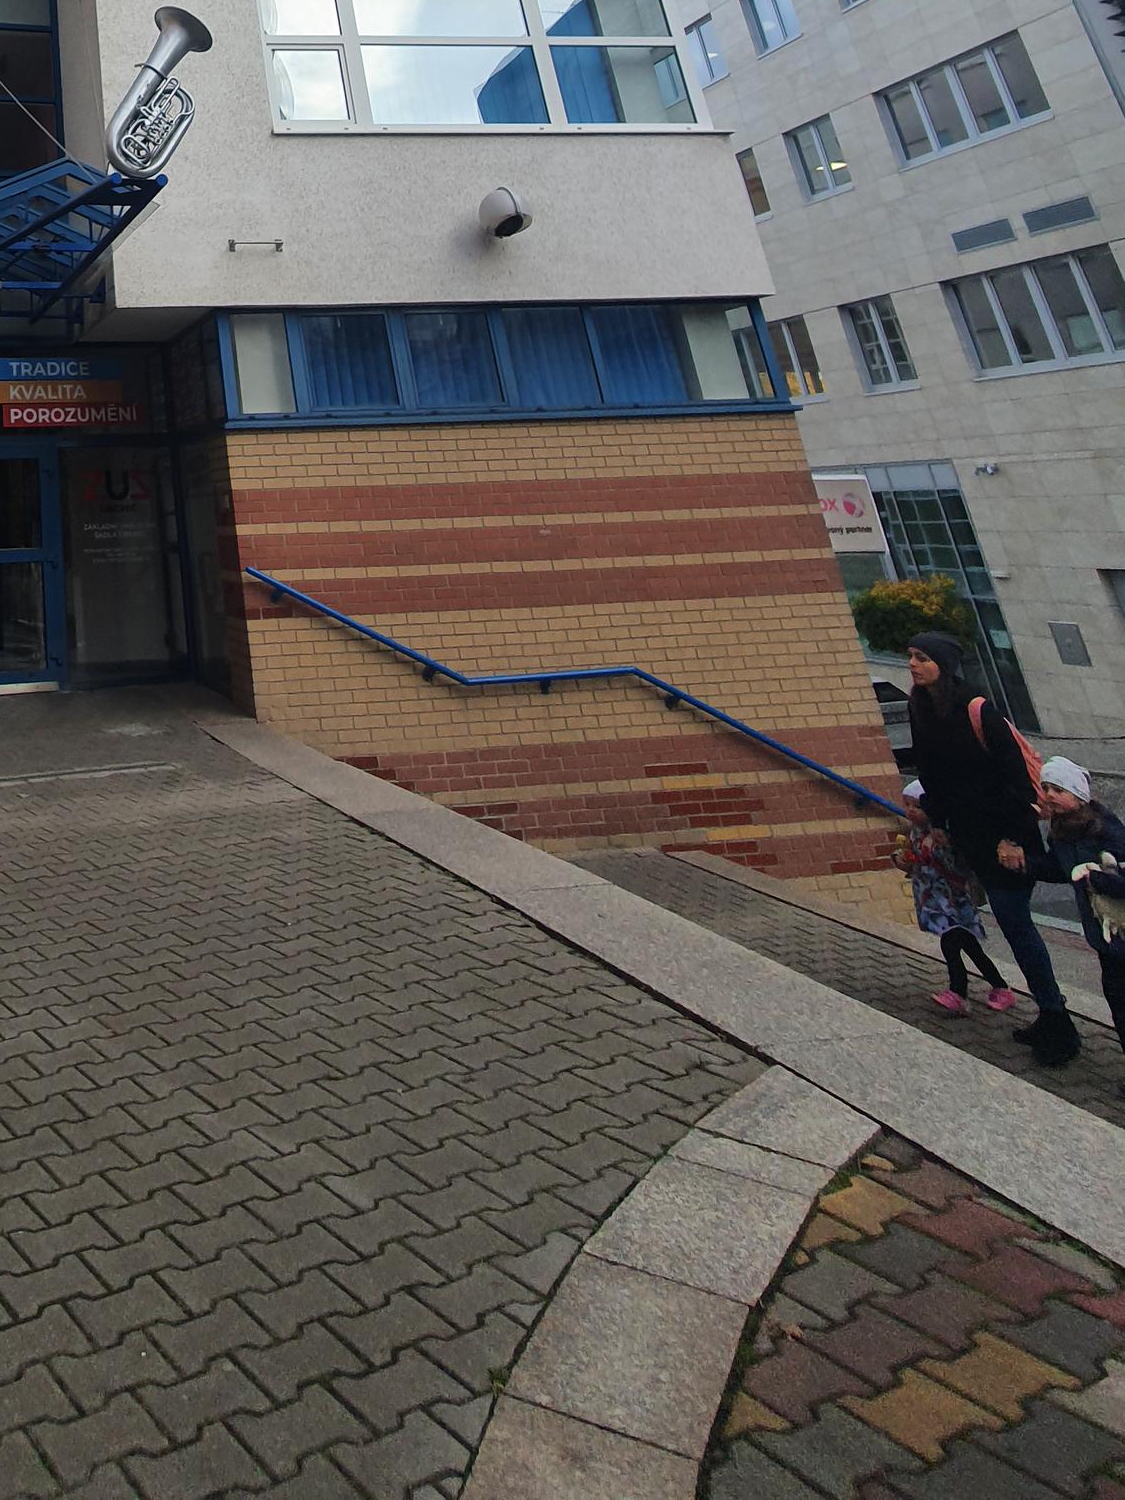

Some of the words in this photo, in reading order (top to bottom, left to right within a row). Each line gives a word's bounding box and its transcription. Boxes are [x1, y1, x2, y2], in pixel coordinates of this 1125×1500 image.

[9, 361, 90, 377] TRADICE
[9, 384, 87, 400] KVALITA
[10, 403, 138, 424] POROZUMĚNÍ
